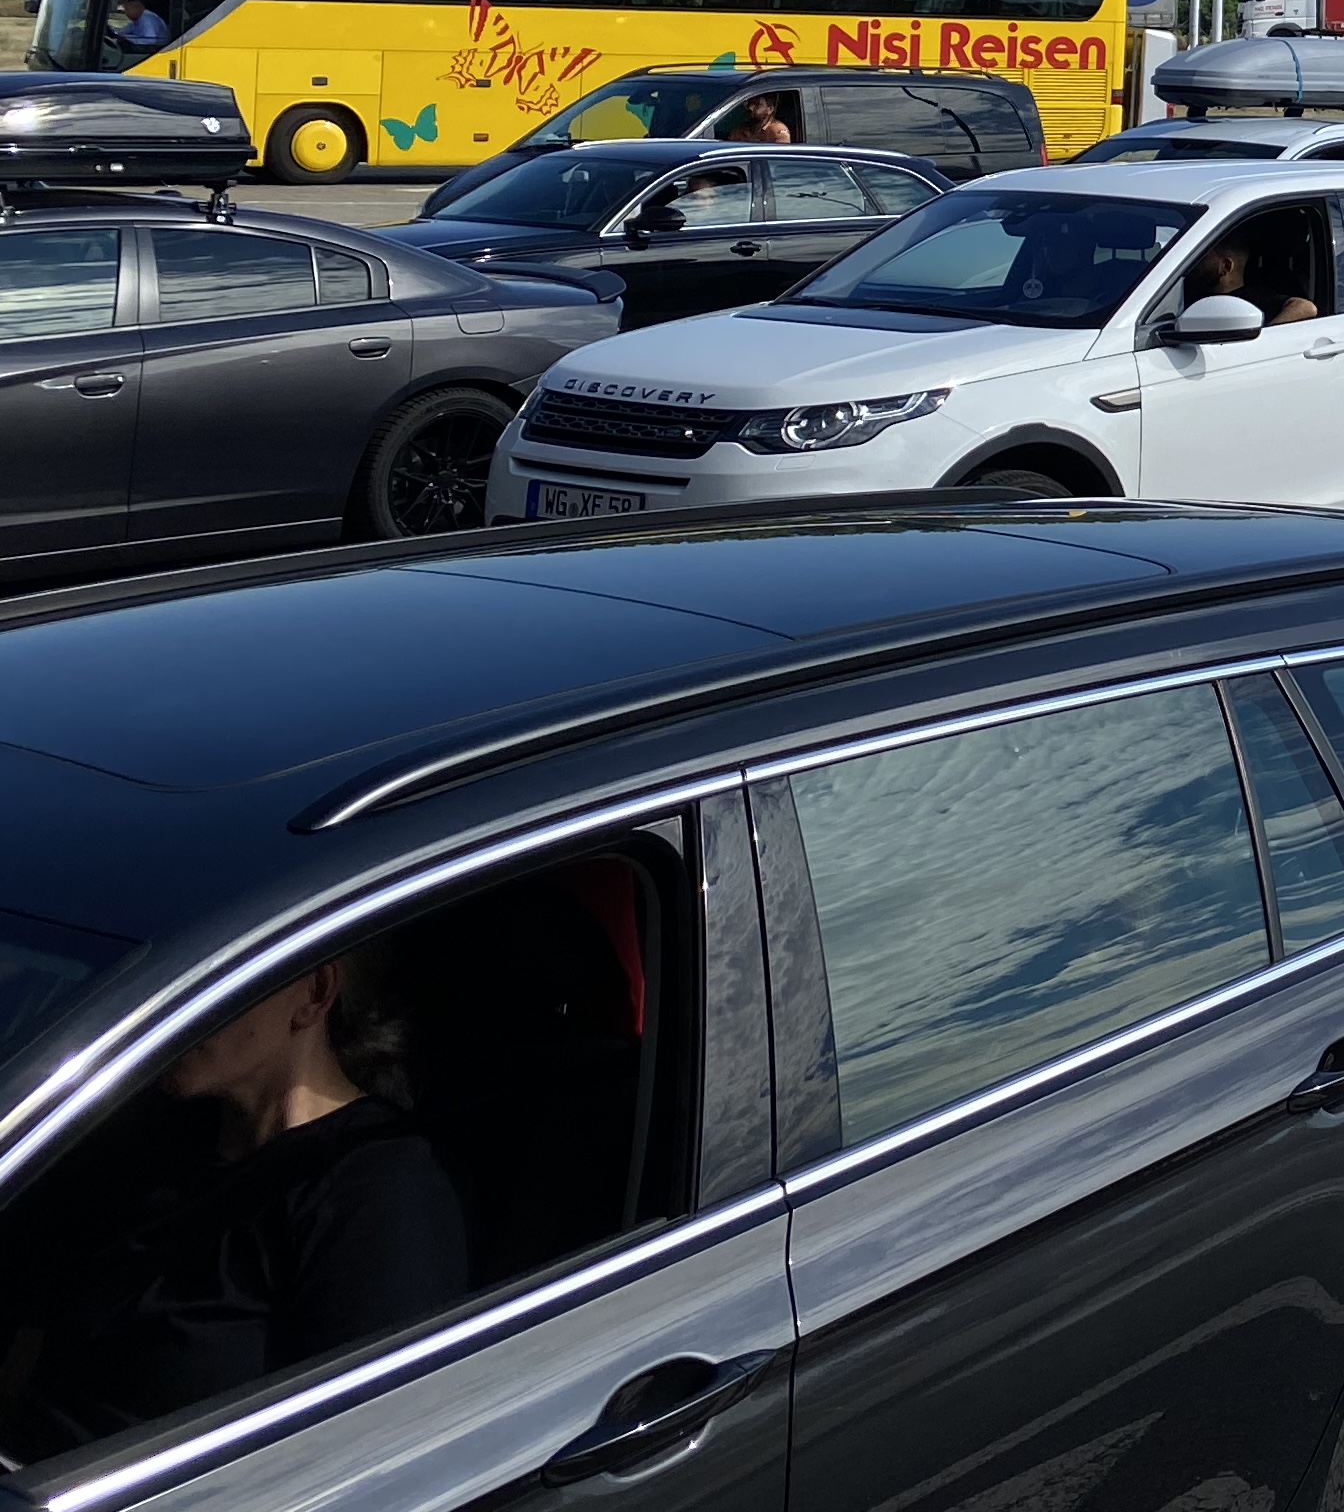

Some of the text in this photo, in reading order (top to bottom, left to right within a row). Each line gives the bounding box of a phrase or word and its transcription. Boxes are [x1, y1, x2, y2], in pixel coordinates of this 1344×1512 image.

[827, 18, 1107, 70] Nisi Reisen
[563, 378, 716, 405] DISCOVERY
[545, 488, 568, 517] WG
[580, 492, 604, 517] XF
